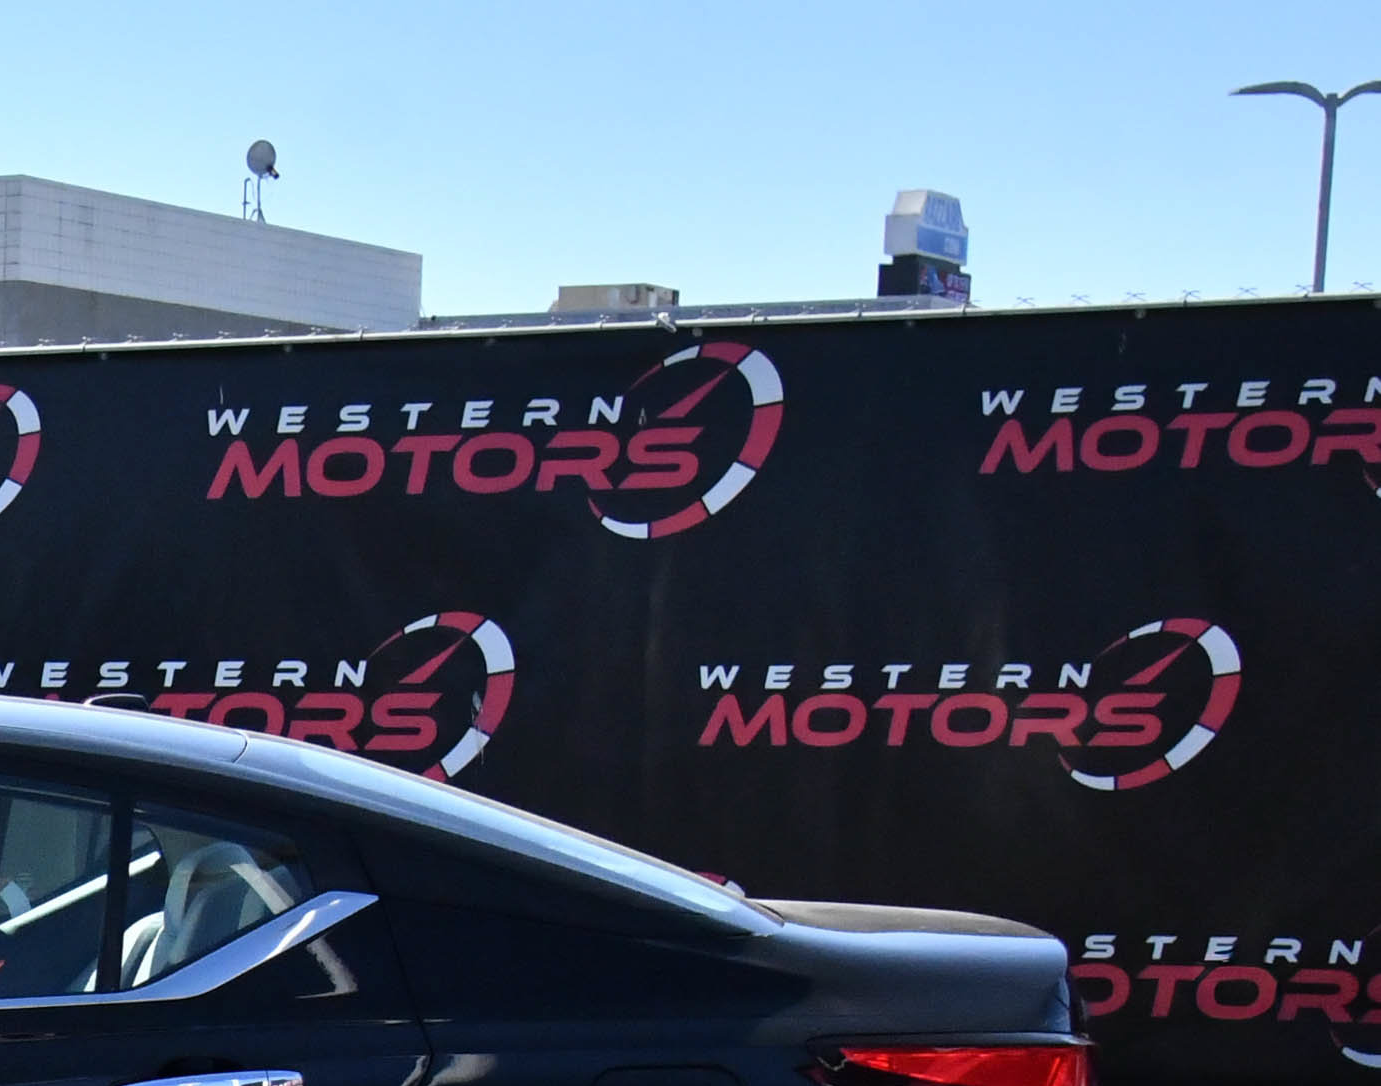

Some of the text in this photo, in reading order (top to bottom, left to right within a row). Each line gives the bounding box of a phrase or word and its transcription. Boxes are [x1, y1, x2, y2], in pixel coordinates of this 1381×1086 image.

[207, 395, 624, 437] WESTERN
[981, 407, 1381, 473] MOTOR
[206, 426, 703, 500] MOTORS
[699, 663, 1092, 690] WESTERN
[148, 692, 441, 752] TORS
[699, 691, 1167, 748] MOTORS
[1082, 935, 1362, 965] STERN
[1070, 962, 1381, 1024] OTOR
